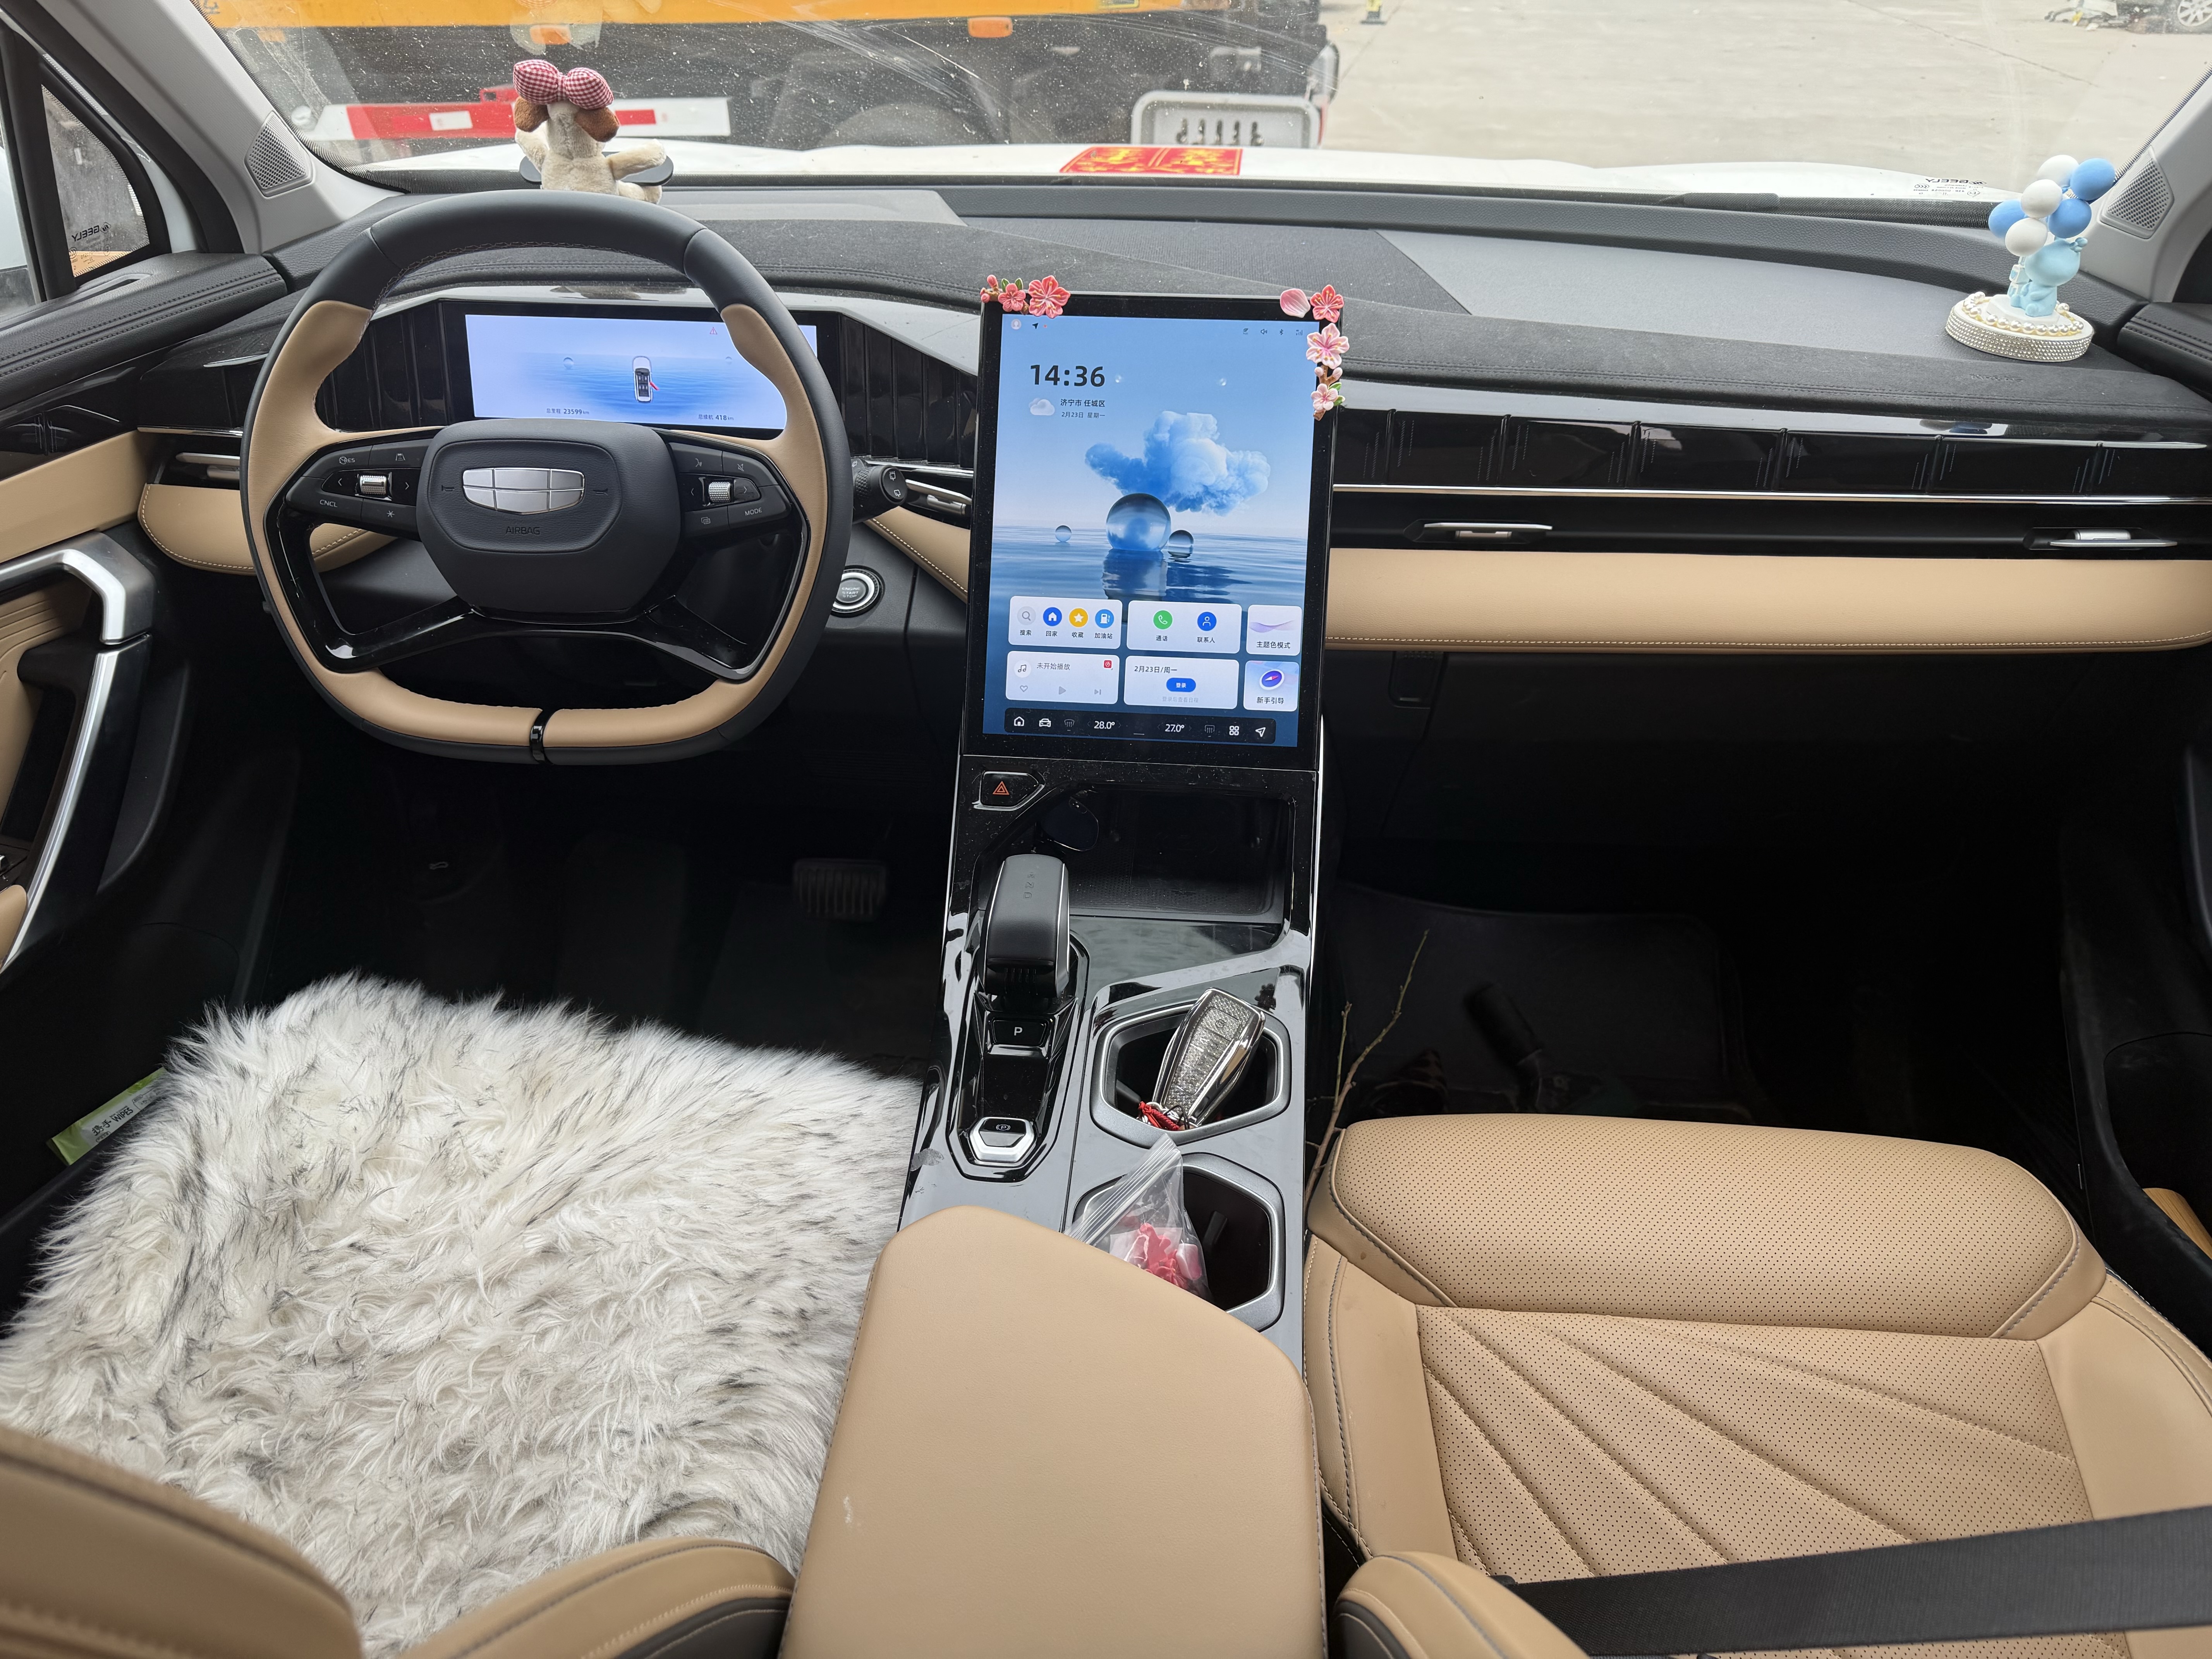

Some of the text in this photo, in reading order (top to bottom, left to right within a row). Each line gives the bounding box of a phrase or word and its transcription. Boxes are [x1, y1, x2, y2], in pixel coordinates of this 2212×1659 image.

[1030, 364, 1105, 387] 14:36
[745, 507, 762, 516] MODE
[505, 526, 541, 535] AIRBAG
[1094, 720, 1115, 729] 28.0°
[1164, 723, 1185, 732] 27.0°
[1014, 1027, 1023, 1036] P
[112, 1107, 133, 1122] WIPES
